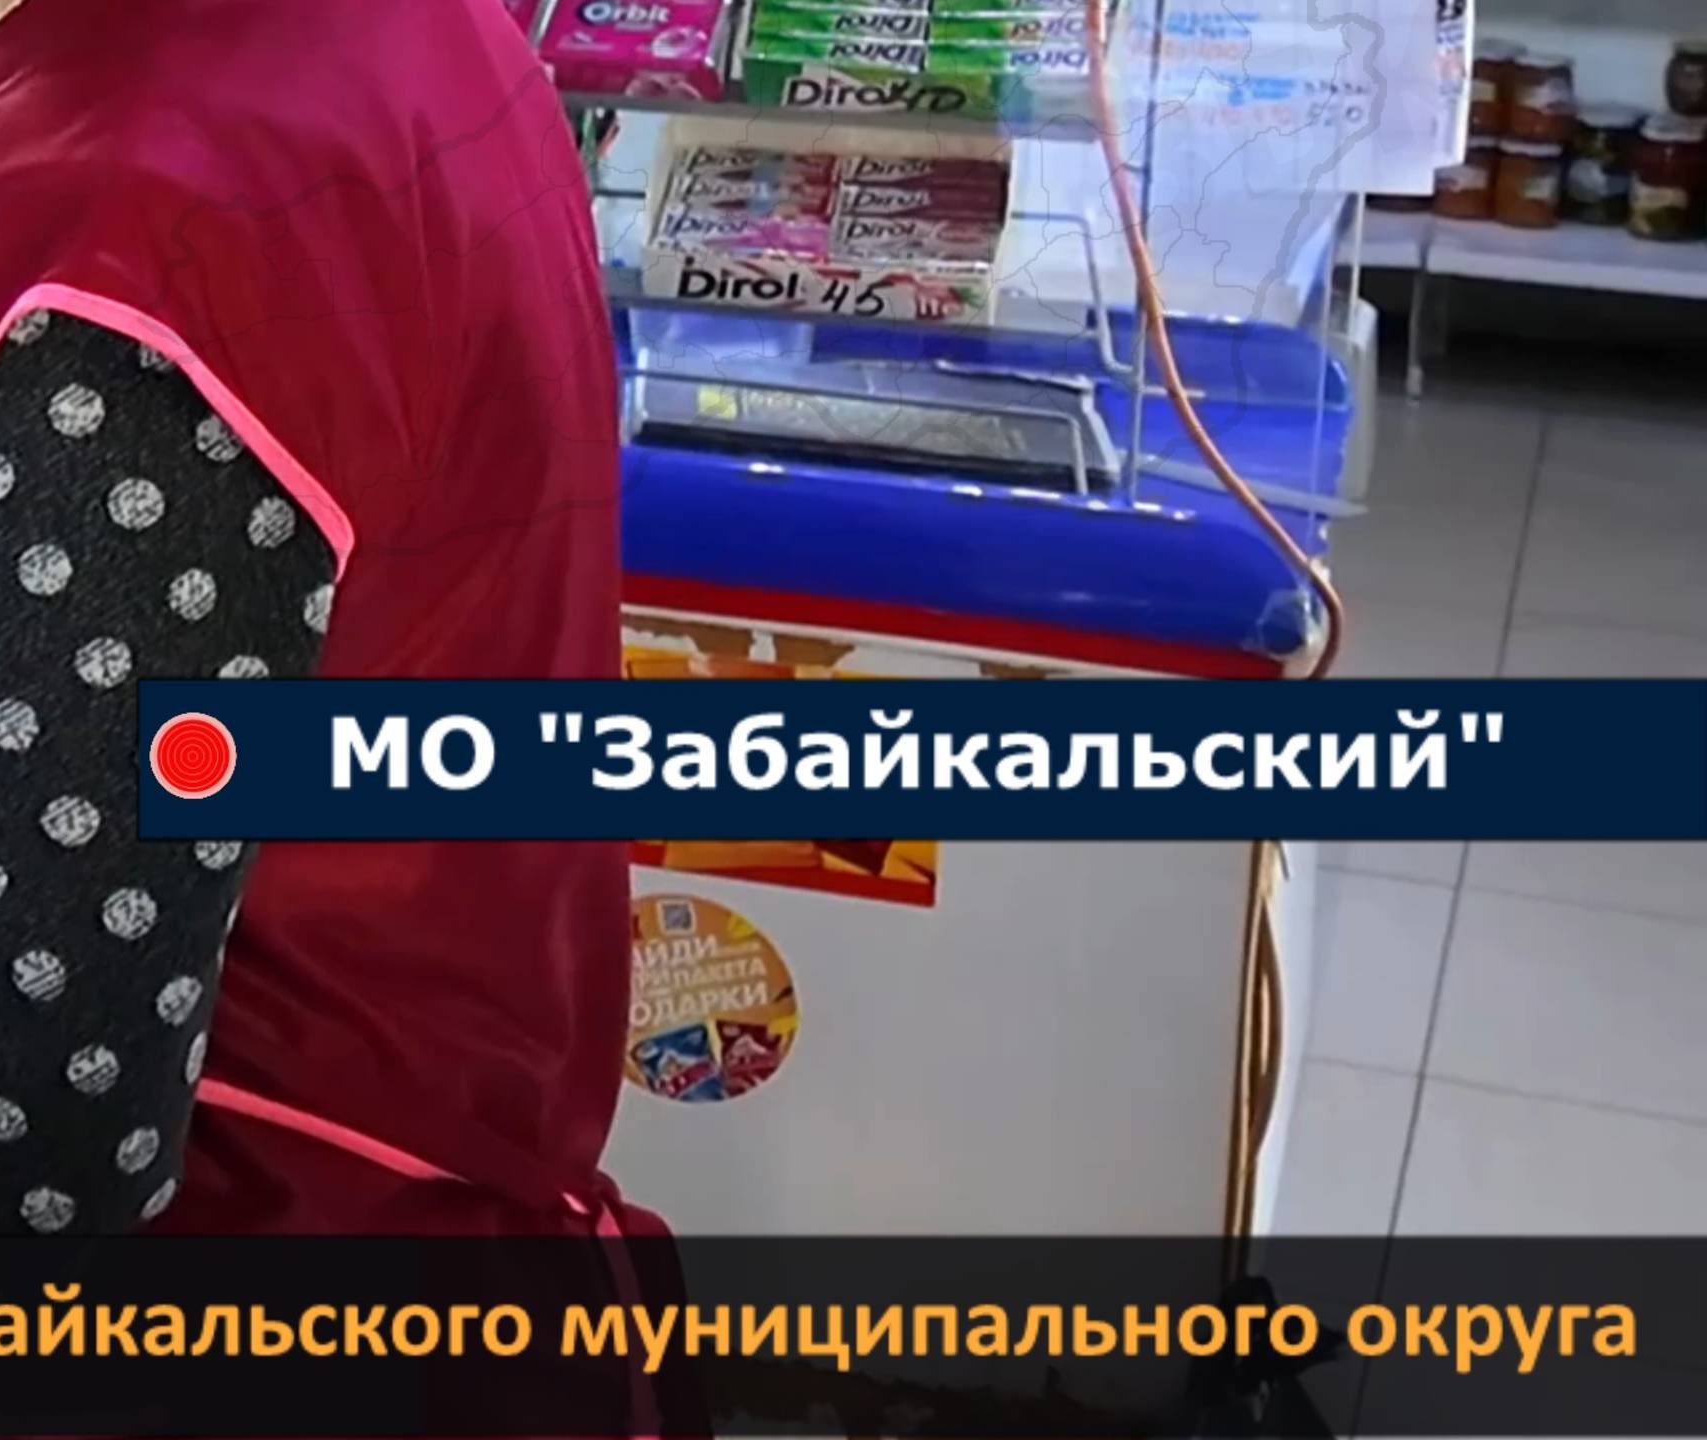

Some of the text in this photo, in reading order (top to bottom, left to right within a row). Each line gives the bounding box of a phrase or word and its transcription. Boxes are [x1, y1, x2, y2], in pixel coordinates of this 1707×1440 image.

[678, 267, 799, 300] Dirol
[822, 276, 887, 318] 45
[629, 980, 769, 1028] ОДАРКИ
